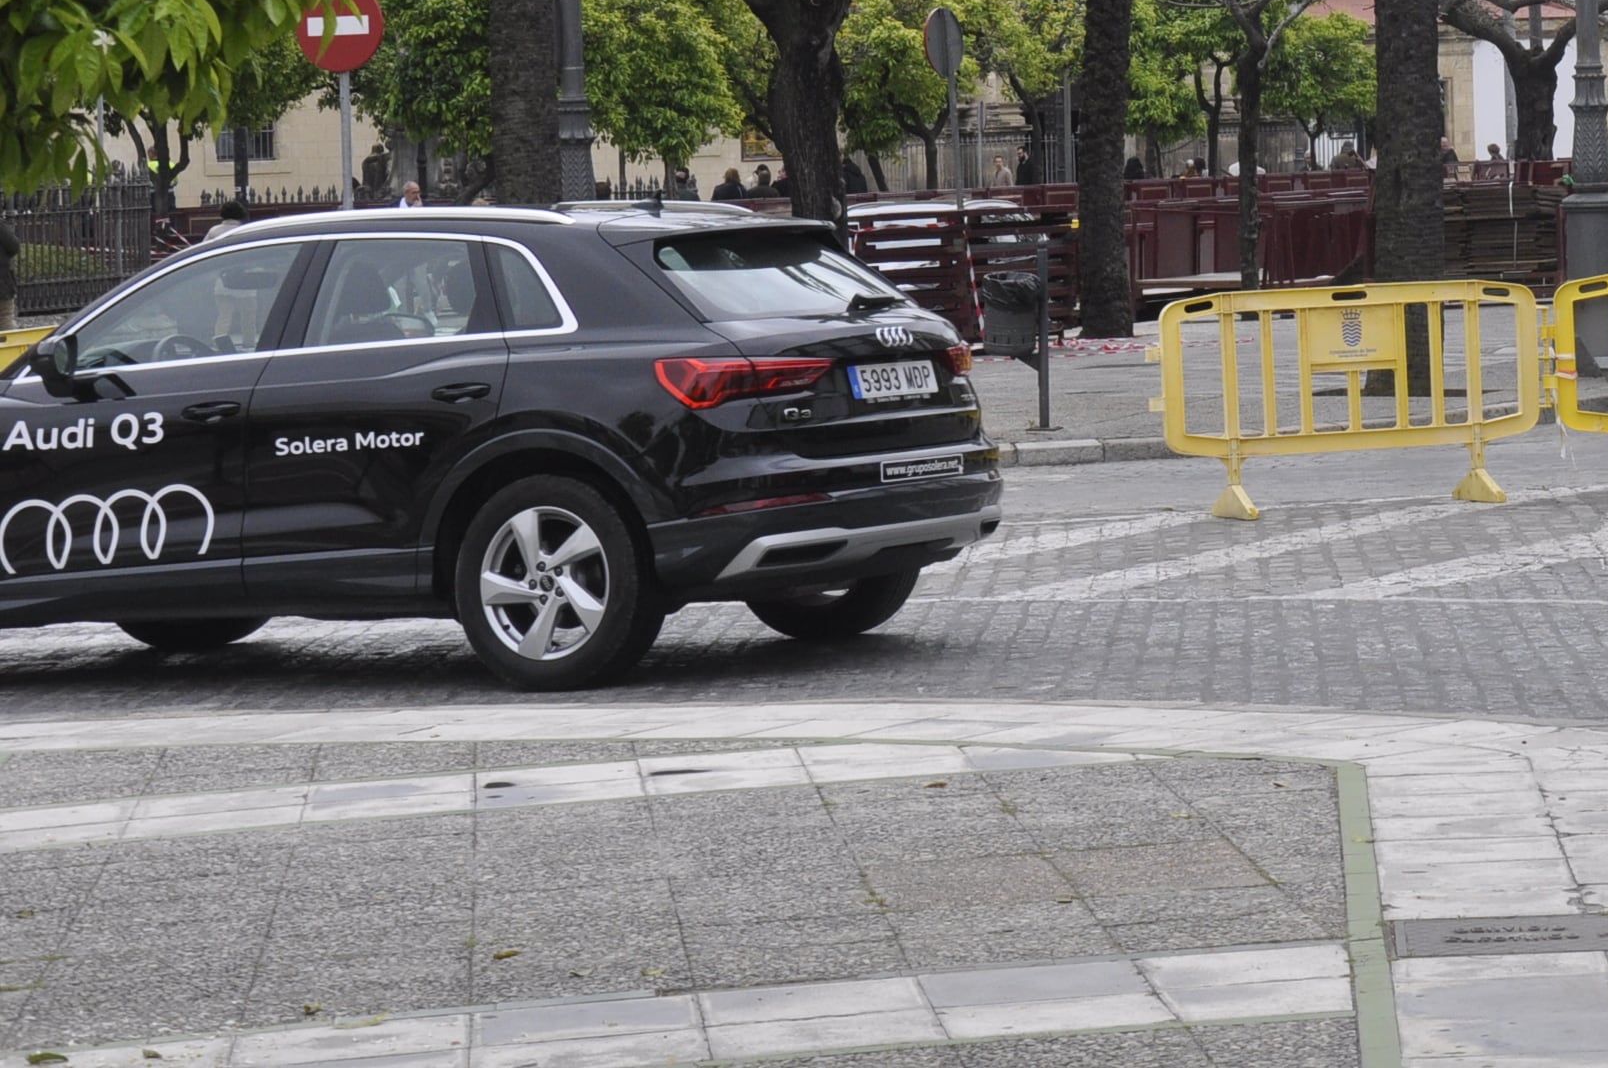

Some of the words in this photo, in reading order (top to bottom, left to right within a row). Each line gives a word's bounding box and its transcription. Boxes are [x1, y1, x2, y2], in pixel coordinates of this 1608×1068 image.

[860, 367, 901, 393] 5993
[904, 365, 931, 390] MDP
[783, 407, 812, 420] Q3
[2, 418, 95, 451] Audi
[110, 411, 165, 450] Q3
[274, 436, 349, 457] Solera
[355, 429, 425, 450] Motor
[886, 460, 959, 478] www.gruposolera.net
